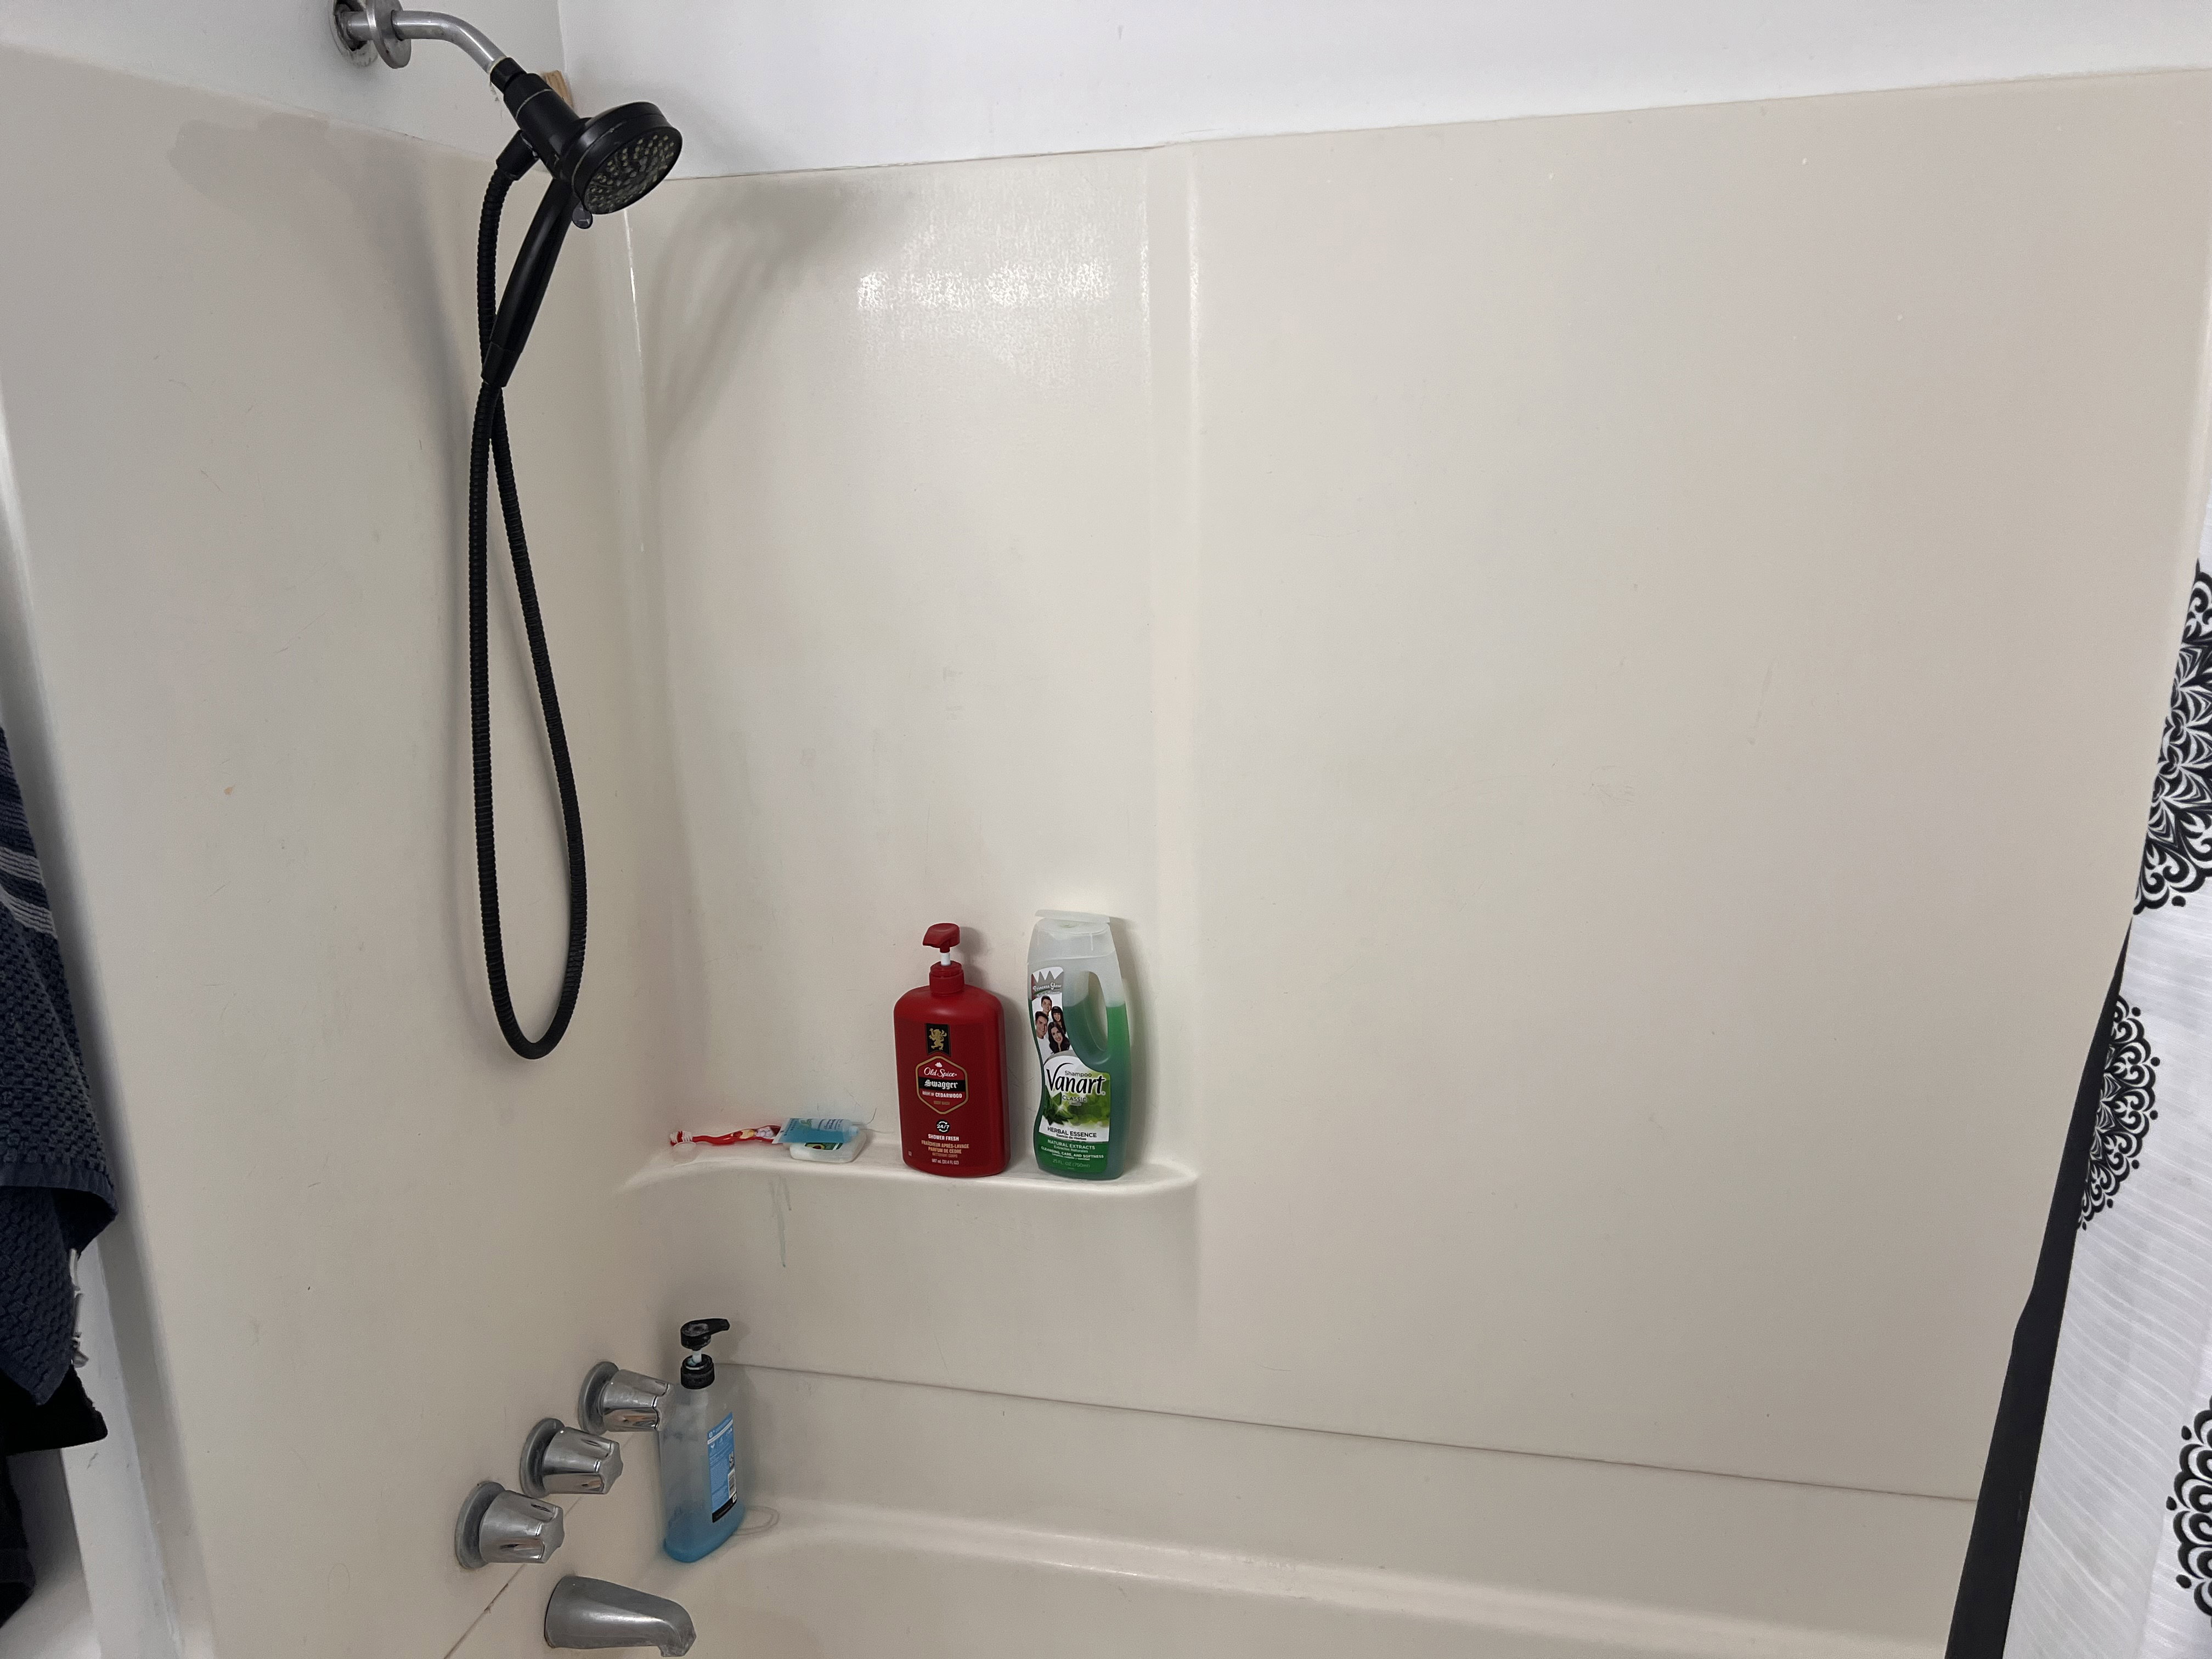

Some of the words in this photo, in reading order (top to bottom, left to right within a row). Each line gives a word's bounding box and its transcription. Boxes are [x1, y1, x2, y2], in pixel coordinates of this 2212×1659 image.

[924, 1067, 938, 1076] Old
[937, 1069, 956, 1078] Spice
[1046, 1062, 1105, 1094] Vanart
[924, 1080, 958, 1090] Swagger
[1047, 1126, 1069, 1136] HERBAL
[1047, 1139, 1069, 1147] NATURAL
